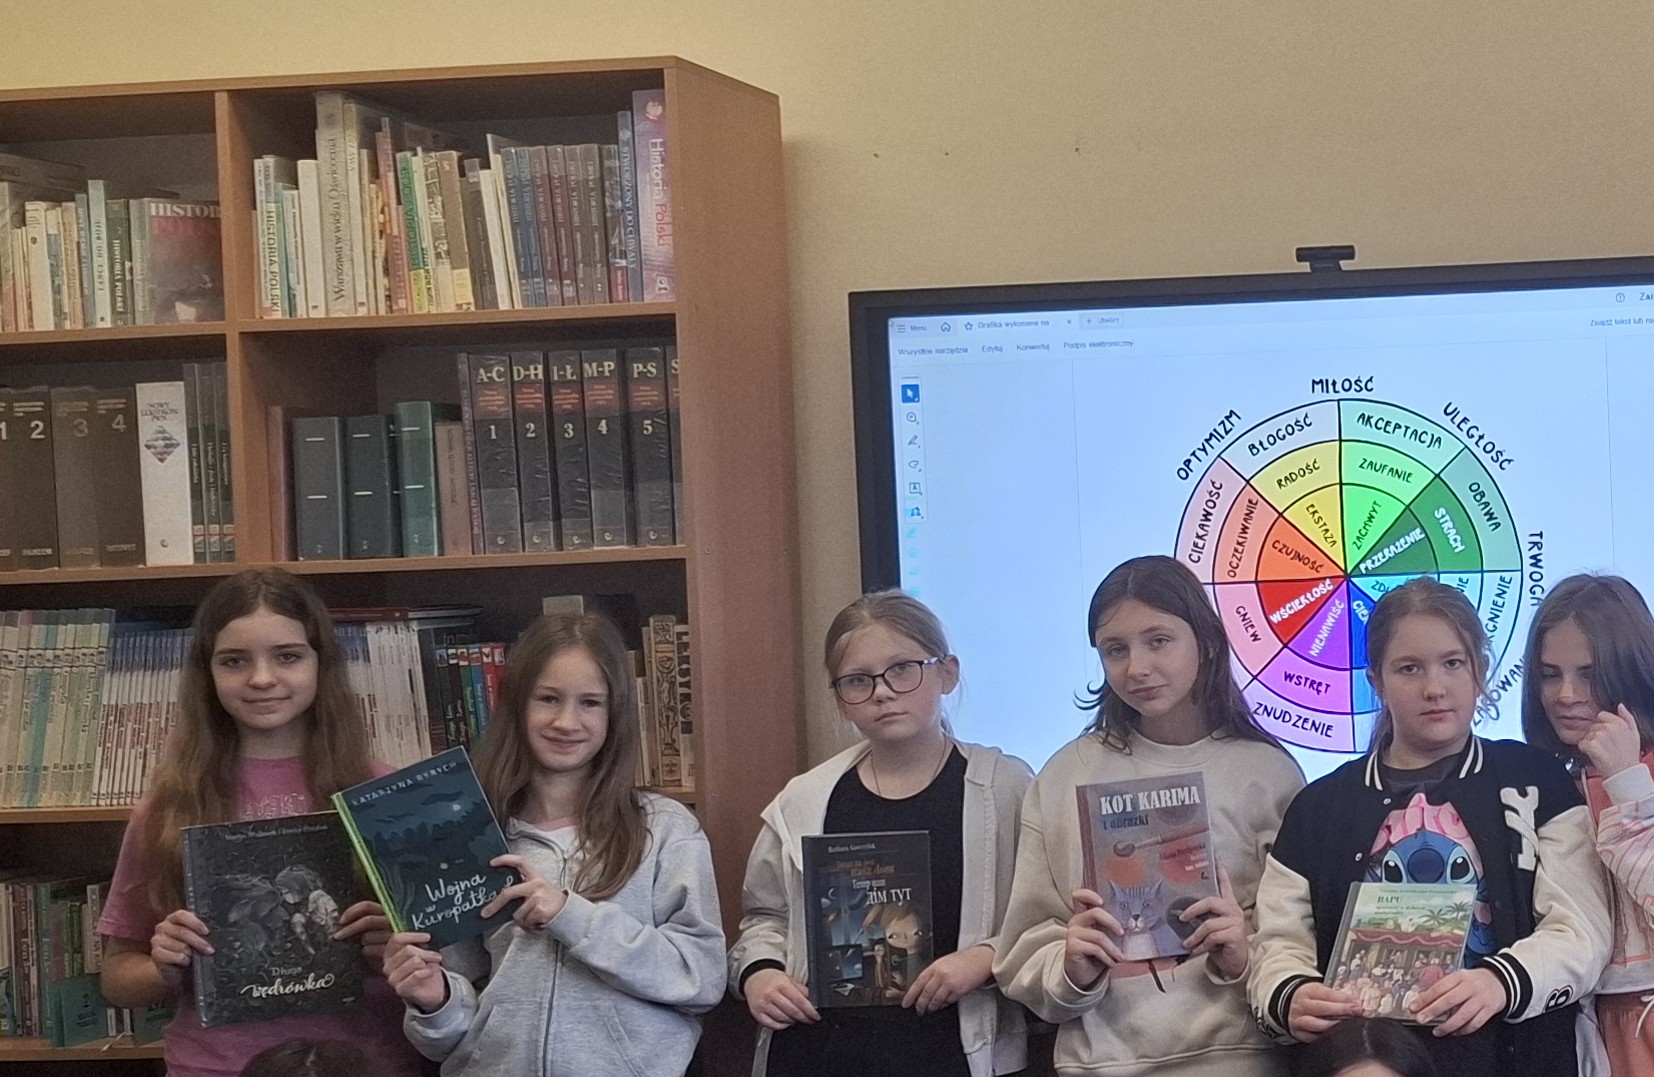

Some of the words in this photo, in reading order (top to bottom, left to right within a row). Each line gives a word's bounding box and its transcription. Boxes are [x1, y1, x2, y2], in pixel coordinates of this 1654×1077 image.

[650, 138, 667, 202] Historia
[266, 210, 276, 265] HISTORIA
[655, 203, 669, 247] Polski
[333, 243, 346, 301] Warszawa
[270, 266, 281, 313] POLSKI
[476, 366, 505, 383] A-C
[513, 365, 543, 381] D-H
[553, 366, 577, 381] I-Ł
[583, 361, 615, 378] M-P
[633, 362, 657, 378] P-S
[1311, 376, 1374, 394] MIŁOŚĆ
[30, 420, 46, 439] 2
[73, 418, 88, 438] 3
[112, 414, 127, 433] 4
[489, 425, 497, 440] 1
[526, 423, 536, 438] 2
[564, 423, 574, 438] 3
[598, 420, 608, 435] 4
[643, 420, 653, 436] 5
[1247, 413, 1313, 457] BŁOGOŚĆ
[1356, 412, 1442, 450] AKCEPTACJA
[1443, 402, 1514, 470] ULEGŁOŚĆ
[1176, 409, 1241, 481] OPTYMIZM
[1276, 458, 1320, 490] RADOŚĆ
[1358, 458, 1414, 484] ZAUFANIE
[1188, 479, 1224, 564] CIEKAWOŚĆ
[1468, 482, 1502, 532] OBAWA
[1227, 498, 1259, 578] OCZEKIWANIE
[1305, 504, 1337, 548] EKSTAZA
[1271, 539, 1326, 573] CZUJNOŚĆ
[1358, 527, 1426, 575] PRZERAŻENIE
[1269, 577, 1335, 624] WŚCIEKŁOŚĆ
[1235, 605, 1262, 643] GNIEW
[1308, 598, 1345, 657] NIENAWIŚĆ
[1284, 670, 1331, 695] WSTRĘT
[1252, 702, 1334, 738] ZNUDZENIE
[1100, 794, 1134, 815] KOT
[1137, 785, 1201, 810] KARIMA
[1109, 814, 1150, 828] obrazki
[412, 875, 514, 930] Kuropatka
[425, 874, 487, 905] Wojna
[425, 904, 436, 913] w
